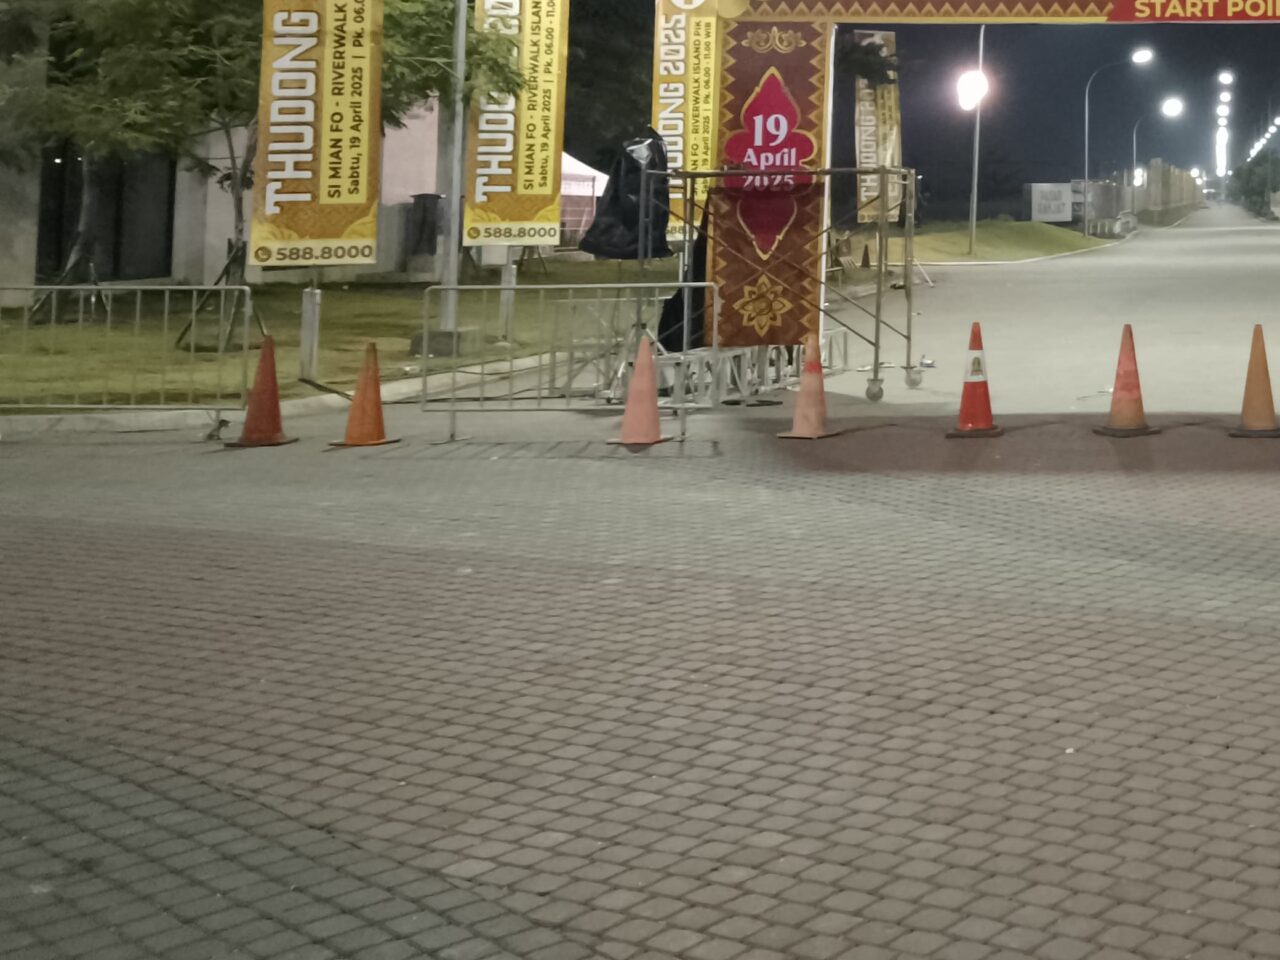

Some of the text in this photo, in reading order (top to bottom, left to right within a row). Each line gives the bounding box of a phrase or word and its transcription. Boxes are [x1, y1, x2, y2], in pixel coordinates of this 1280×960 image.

[353, 27, 364, 48] Pk.
[545, 26, 554, 55] 06.00
[694, 20, 702, 36] PIK
[331, 3, 347, 96] RIVERWALK
[660, 14, 686, 75] 2025
[693, 39, 701, 74] ISLAND
[351, 67, 363, 97] 2025
[527, 39, 540, 111] RIVERWALK
[542, 88, 552, 112] 2025
[691, 77, 700, 134] RIVERWALK
[265, 11, 319, 215] THUDONG
[330, 112, 344, 133] FO
[349, 101, 364, 132] April
[475, 43, 517, 204] THUDO
[702, 115, 710, 134] 2025
[526, 123, 536, 139] FO
[541, 115, 552, 140] April
[752, 113, 788, 147] 19
[349, 136, 360, 149] 19
[540, 142, 549, 153] 19
[691, 143, 699, 157] FO
[702, 137, 710, 156] April
[328, 138, 343, 178] MIAN
[524, 143, 536, 176] MIAN
[743, 147, 797, 171] April
[348, 153, 362, 194] Sabtu,
[538, 155, 550, 188] Sabtu,
[328, 184, 341, 198] SI
[524, 179, 534, 190] SI
[483, 227, 557, 238] 588.8000
[275, 244, 373, 261] 588.8000
